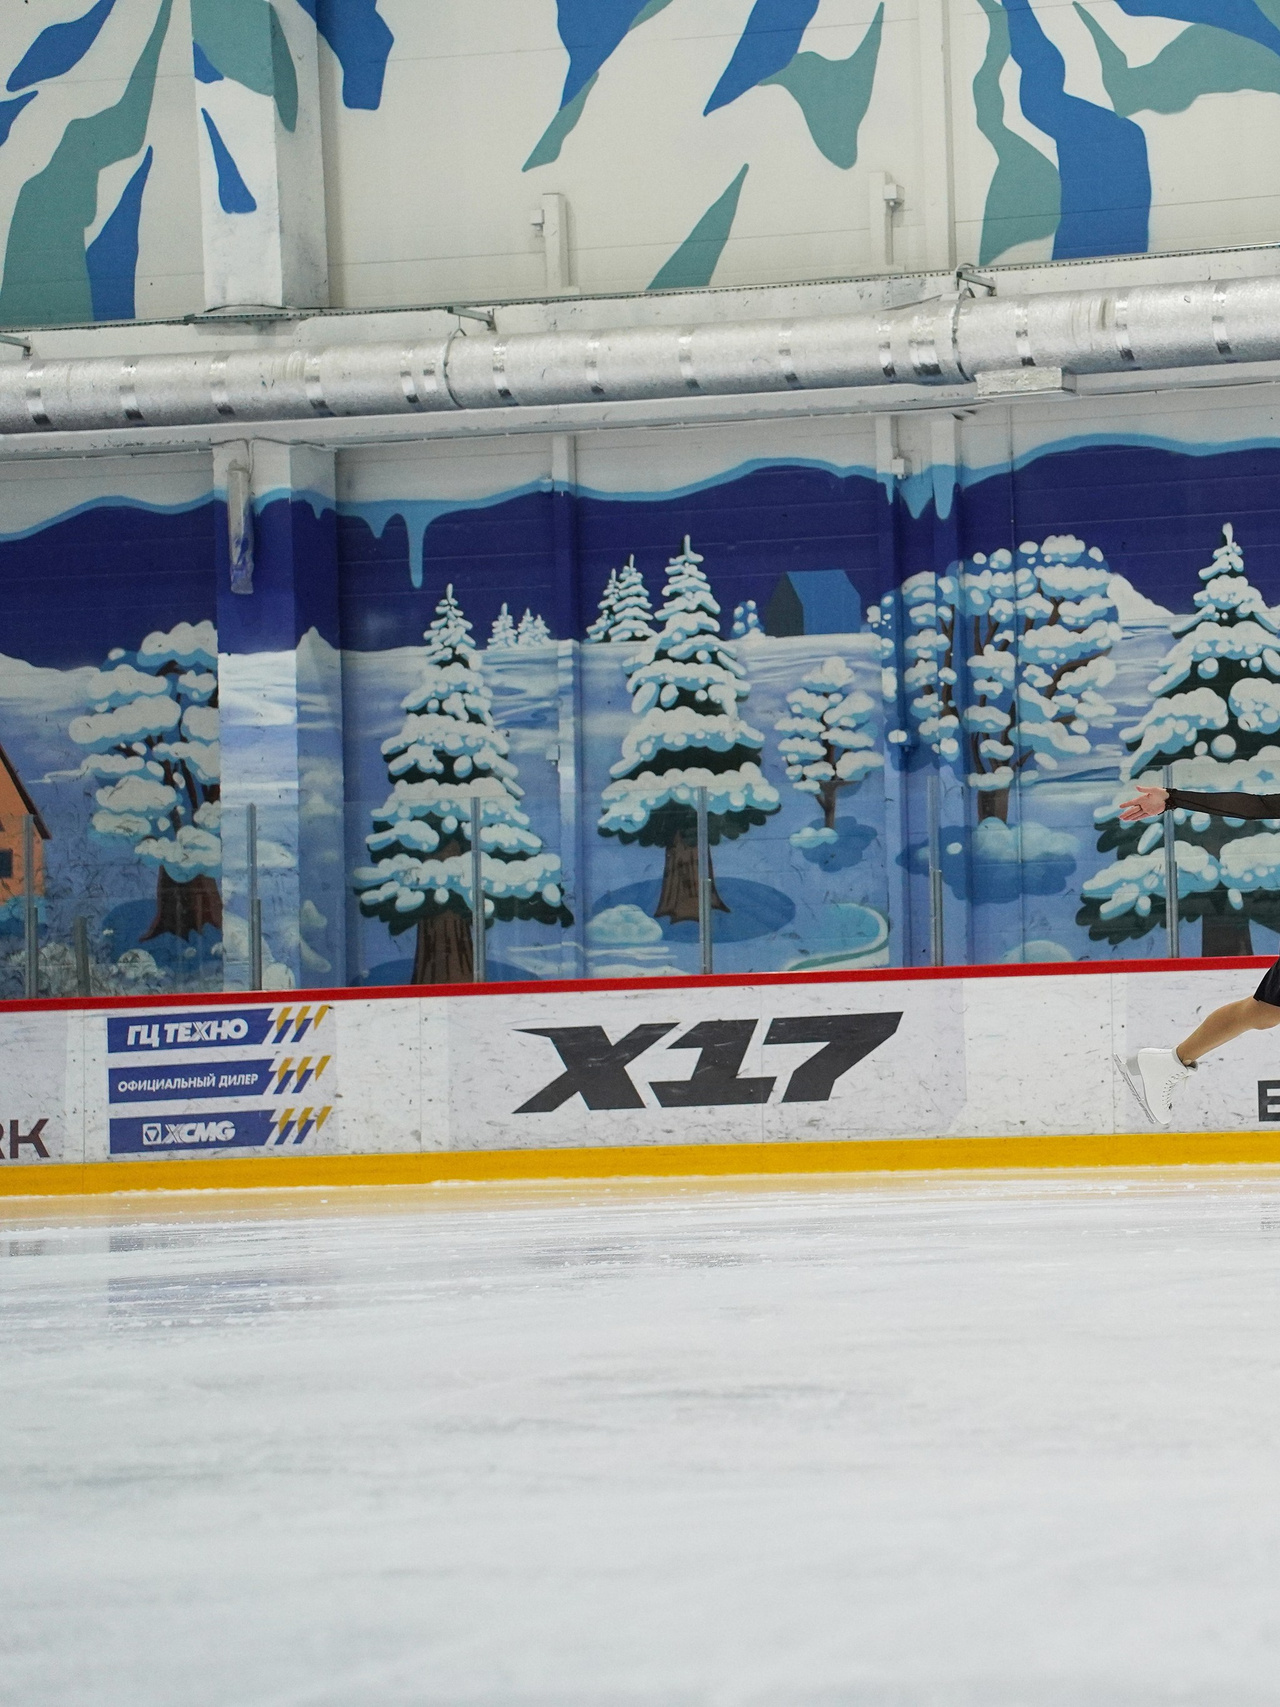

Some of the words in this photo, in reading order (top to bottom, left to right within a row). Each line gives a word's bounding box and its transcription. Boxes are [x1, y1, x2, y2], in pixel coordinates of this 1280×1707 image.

[126, 1025, 160, 1049] ГЦ
[164, 1018, 249, 1044] ТЕХНО
[511, 1010, 904, 1114] X17
[117, 1072, 215, 1093] ОФИЦИАЛЬНЫЙ
[218, 1072, 259, 1089] ДИЛЕР
[0, 1118, 51, 1159] K
[163, 1120, 236, 1145] XCMG
